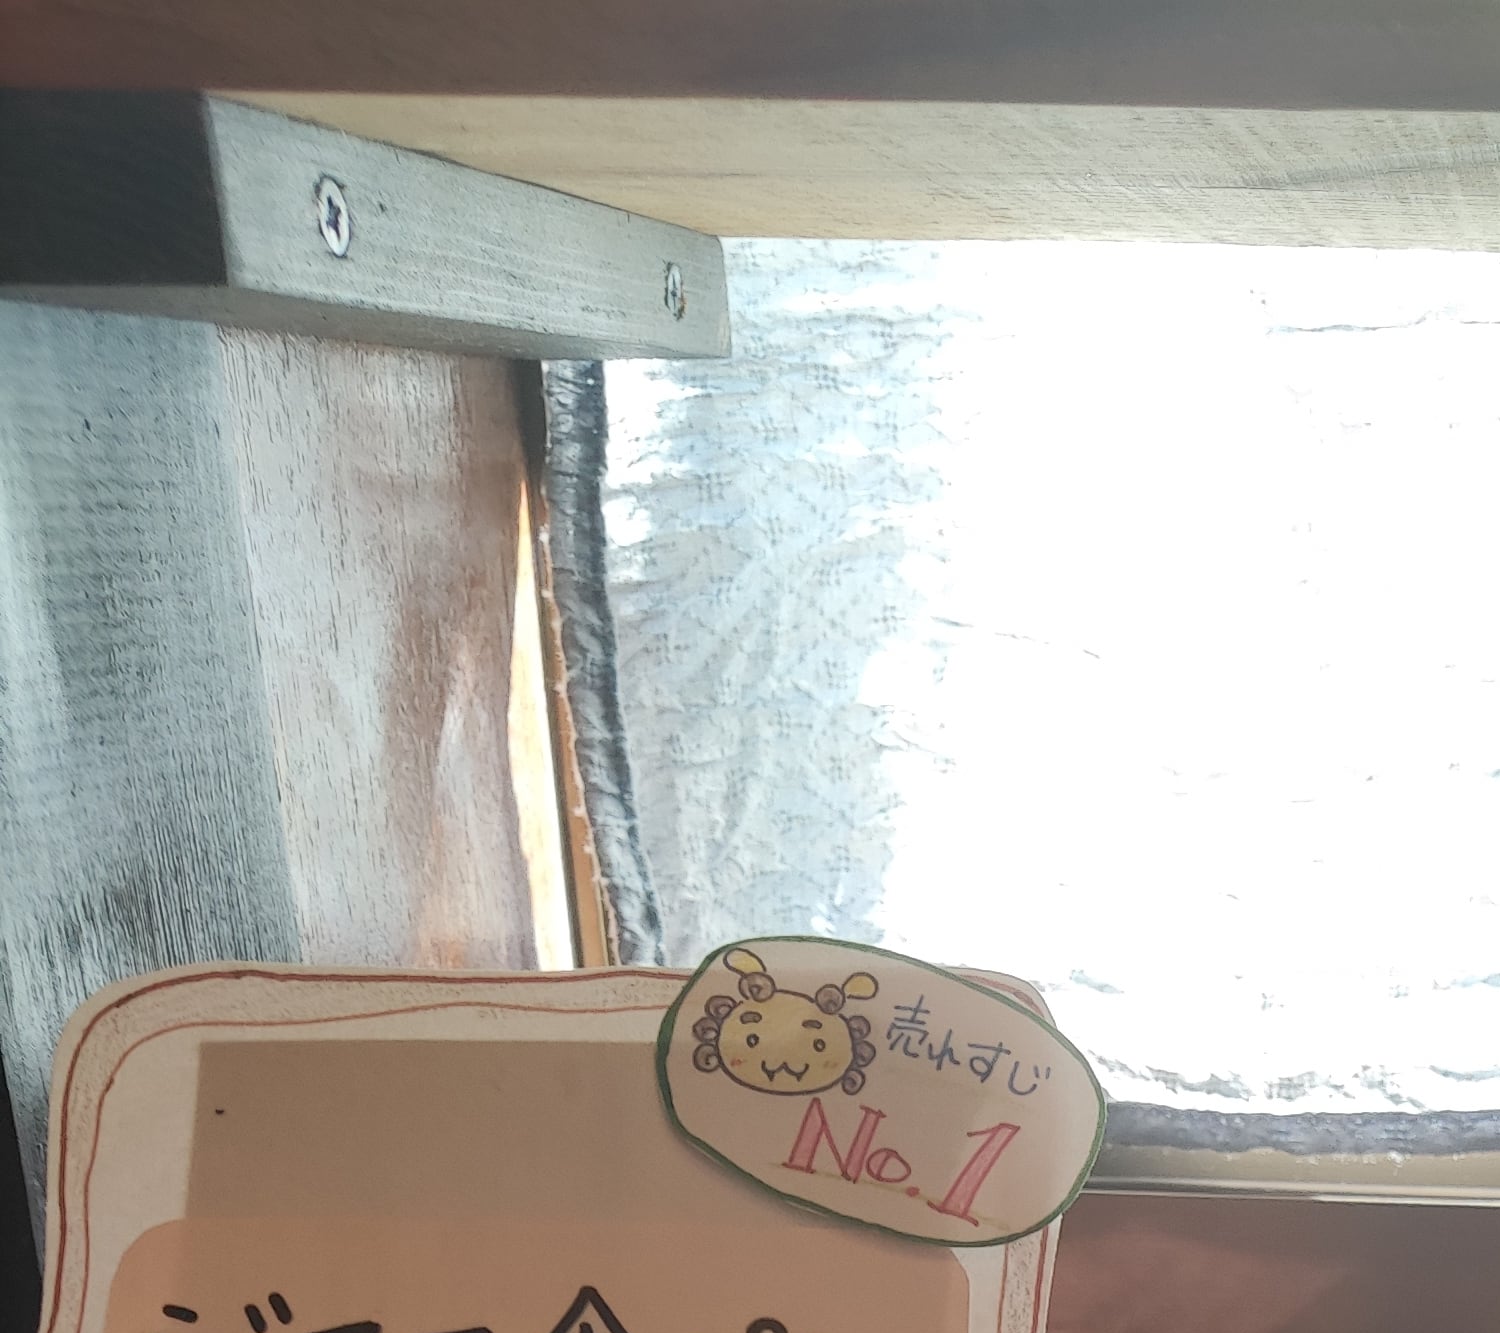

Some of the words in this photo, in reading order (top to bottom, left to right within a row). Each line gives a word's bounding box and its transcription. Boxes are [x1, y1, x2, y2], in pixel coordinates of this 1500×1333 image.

[886, 994, 1052, 1096] 売れすじ
[781, 1097, 1021, 1227] No.1
